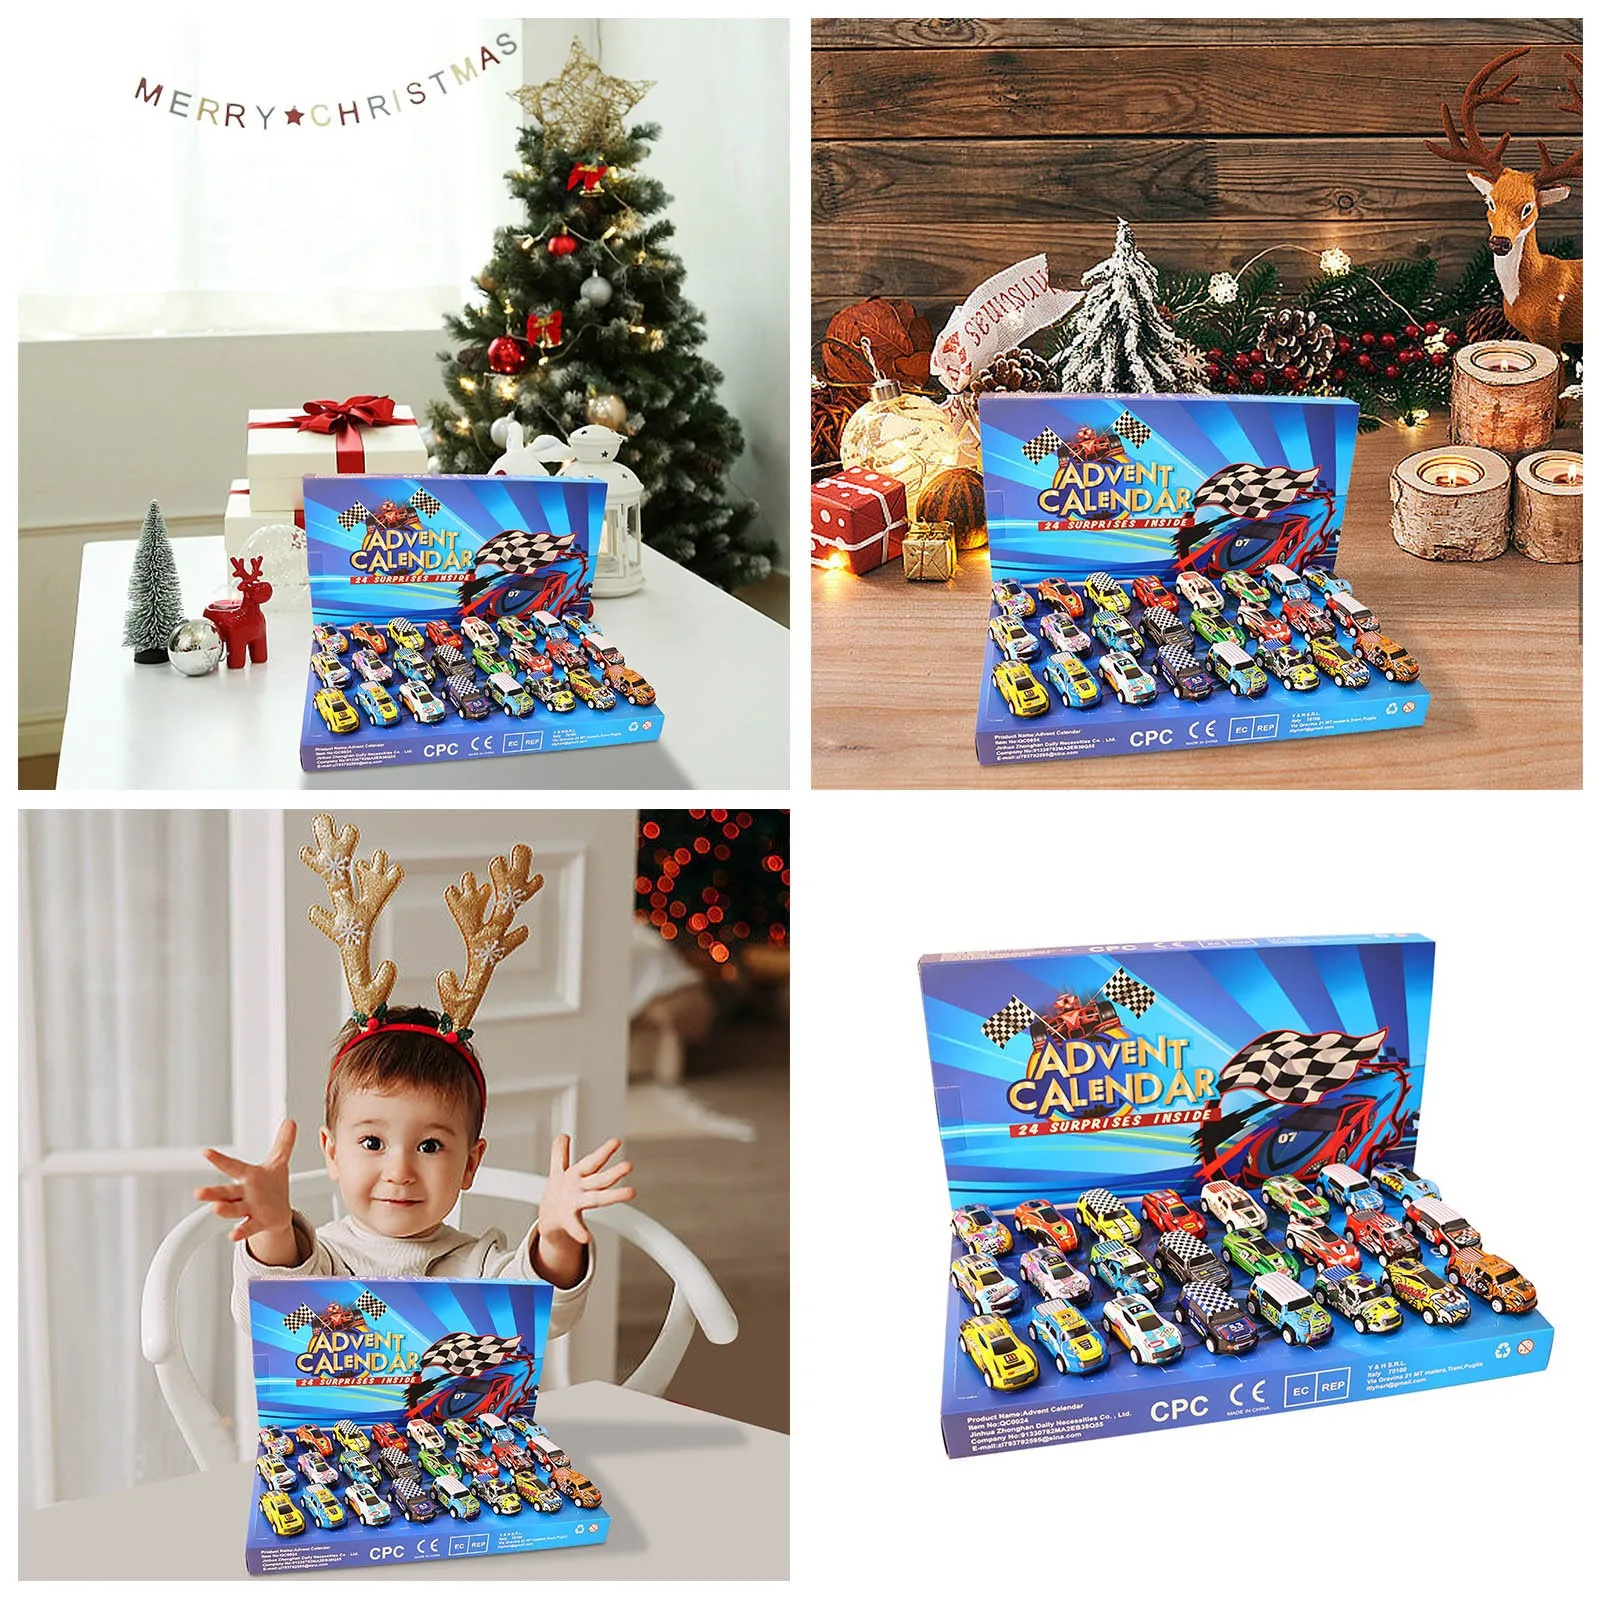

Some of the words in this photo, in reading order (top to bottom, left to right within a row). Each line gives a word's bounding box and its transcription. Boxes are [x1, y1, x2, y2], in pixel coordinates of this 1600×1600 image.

[134, 77, 275, 130] MERRY
[310, 33, 518, 127] CHRISTMAS
[1059, 462, 1175, 489] ADVENT
[1038, 487, 1192, 514] CALENDAR
[1044, 521, 1060, 530] 24
[1068, 519, 1137, 530] SURPRISES
[1144, 518, 1188, 528] INSIDE
[367, 529, 460, 551] ADVENT
[1235, 538, 1251, 548] 07
[350, 549, 474, 571] CALENDAR
[374, 575, 429, 583] SURPRISES
[435, 574, 471, 582] INSIDE
[508, 590, 521, 598] 07
[1188, 719, 1217, 739] CE
[1235, 726, 1248, 734] EC
[1129, 729, 1174, 747] CPC
[423, 743, 459, 757] CPC
[1035, 1034, 1189, 1079] ADVENT
[1009, 1067, 1215, 1115] CALENDAR
[1018, 1123, 1039, 1136] 24
[1050, 1114, 1143, 1134] SURPRISES
[1153, 1108, 1212, 1125] INSIDE
[1277, 1131, 1298, 1145] 07
[1130, 1304, 1147, 1314] 72
[1227, 1321, 1245, 1333] 53
[313, 1331, 406, 1353] ADVENT
[296, 1352, 420, 1373] CALENDAR
[320, 1377, 375, 1386] SURPRISES
[381, 1376, 417, 1384] INSIDE
[1321, 1380, 1346, 1392] REP
[454, 1392, 467, 1400] 07
[1229, 1379, 1267, 1407] CE
[1292, 1386, 1310, 1397] EC
[967, 1414, 998, 1423] Product
[999, 1407, 1049, 1419] Name:Advent
[1050, 1403, 1084, 1413] Calendar
[1150, 1395, 1209, 1423] CPC
[970, 1430, 995, 1438] Jinhua
[996, 1424, 1035, 1435] Zhonghan
[1036, 1421, 1055, 1429] Daily
[971, 1436, 1006, 1445] Company
[369, 1545, 405, 1560] CPC
